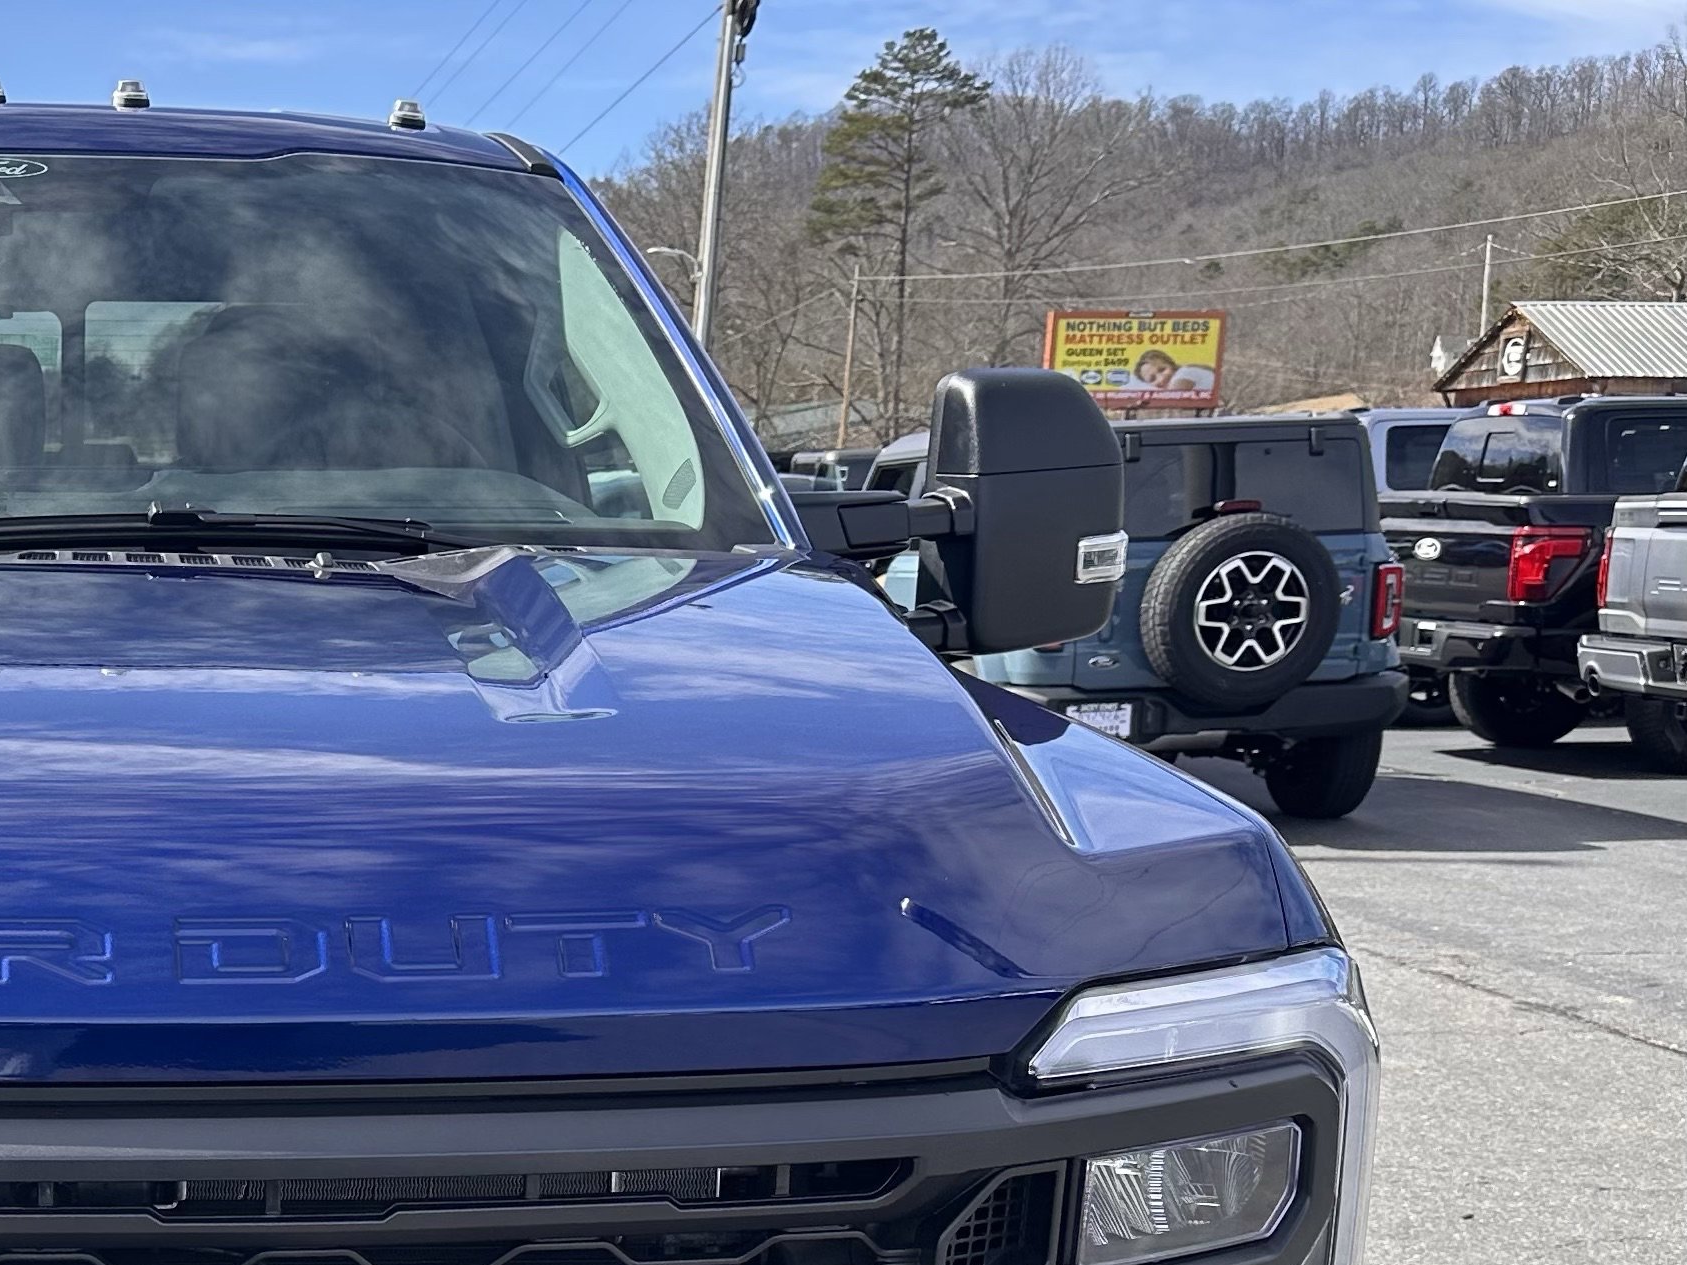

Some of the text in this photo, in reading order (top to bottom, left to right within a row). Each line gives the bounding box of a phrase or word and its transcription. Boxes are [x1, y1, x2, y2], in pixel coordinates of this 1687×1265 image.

[1065, 320, 1210, 332] NOTHING BUT BEDS
[1064, 333, 1208, 345] MATTRESS OUTLET
[1066, 347, 1127, 357] QUEEN SET
[1104, 358, 1130, 367] $499
[173, 904, 793, 986] DUTY
